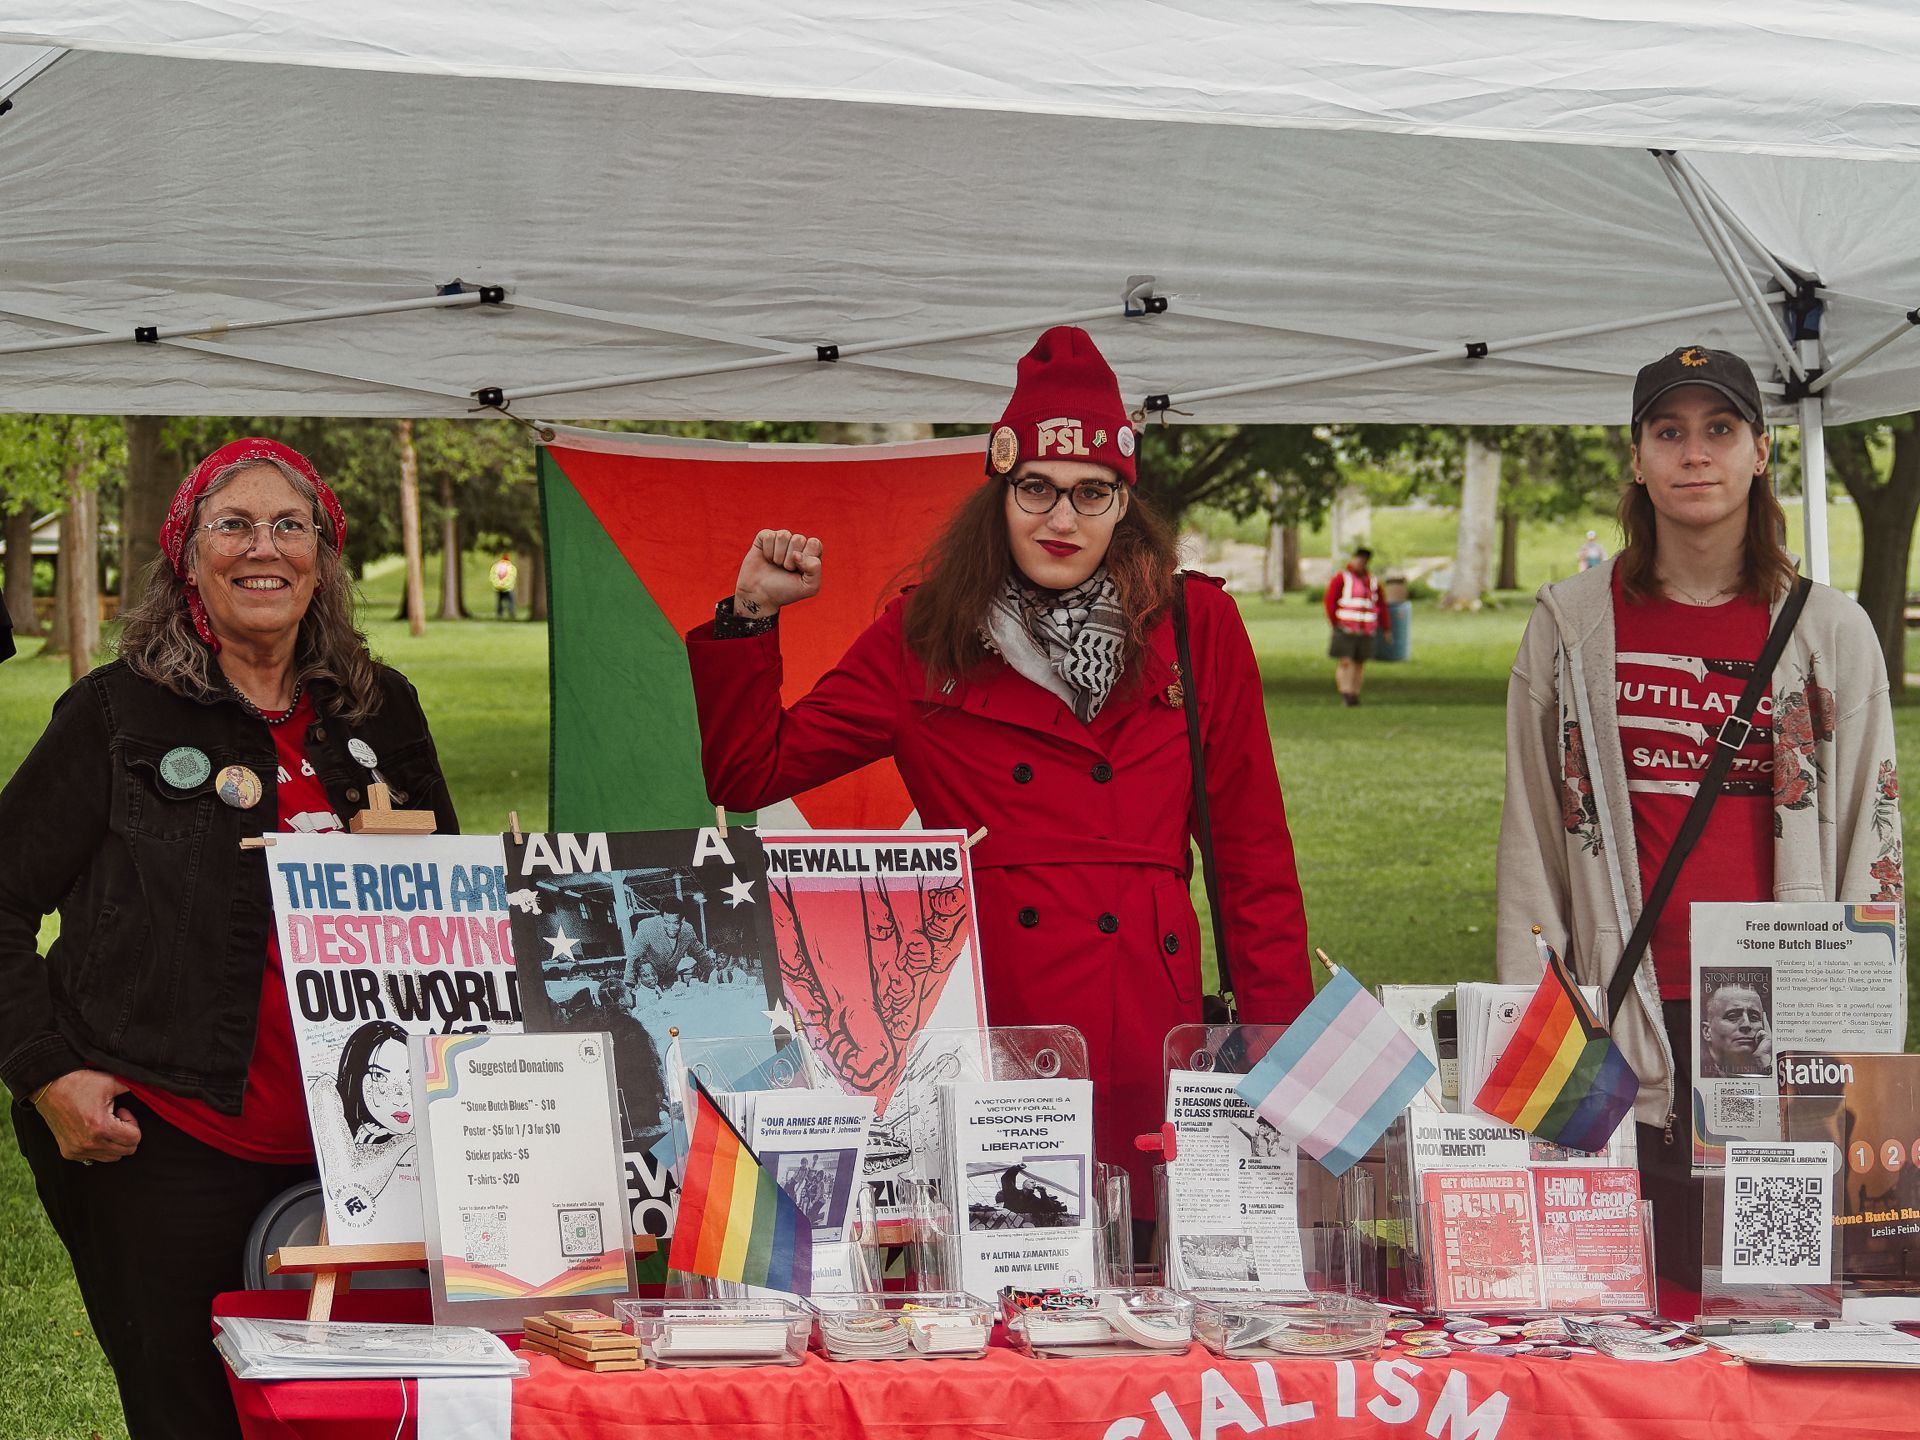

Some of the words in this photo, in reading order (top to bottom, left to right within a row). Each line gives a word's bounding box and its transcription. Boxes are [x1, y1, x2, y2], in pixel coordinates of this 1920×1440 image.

[1038, 429, 1089, 456] PSL
[1616, 681, 1773, 714] UTILATO
[1632, 748, 1774, 772] SALVTIO
[521, 831, 612, 875] AM
[693, 826, 736, 866] A
[876, 846, 957, 871] MEANS
[278, 862, 350, 910] THE
[351, 863, 443, 911] RICH
[1745, 921, 1770, 932] Free
[1774, 920, 1828, 932] download
[1832, 920, 1844, 932] of
[1736, 939, 1775, 950] “Stone
[1778, 939, 1811, 950] Butch
[1815, 939, 1852, 950] Blues”
[1738, 972, 1768, 982] BUTCH
[295, 969, 386, 1021] OUR
[469, 1059, 517, 1076] Suggested
[519, 1058, 564, 1073] Donations
[1778, 1058, 1854, 1087] Station
[488, 1100, 508, 1111] Butch
[510, 1100, 533, 1111] Blues”
[541, 1099, 556, 1110] $18
[1175, 1098, 1180, 1106] 5
[1183, 1098, 1221, 1107] REASONS
[970, 1115, 1032, 1125] LESSONS
[1036, 1114, 1076, 1122] FROM
[1174, 1109, 1182, 1117] IS
[1185, 1109, 1210, 1117] CLASS
[1213, 1109, 1254, 1118] STRUGGLE
[786, 1117, 816, 1126] ARMIES
[818, 1117, 831, 1125] ARE
[1175, 1121, 1179, 1131] 1
[463, 1125, 486, 1136] Poster
[492, 1125, 503, 1136] $5
[505, 1125, 514, 1135] for
[528, 1124, 533, 1134] 3
[534, 1124, 543, 1134] for
[546, 1123, 560, 1134] $10
[761, 1128, 780, 1136] Sylvia
[1416, 1127, 1441, 1141] JOIN
[1444, 1128, 1467, 1141] THE
[1468, 1127, 1526, 1141] SOCIALIST
[466, 1150, 490, 1161] Sticker
[493, 1149, 512, 1162] packs
[518, 1148, 529, 1159] $5
[1416, 1143, 1486, 1156] MOVEMENT!
[1856, 1148, 1865, 1167] 1
[1887, 1146, 1899, 1165] 2
[1239, 1158, 1246, 1169] 2
[468, 1174, 497, 1185] T-shirts
[503, 1173, 519, 1184] $20
[1440, 1178, 1457, 1188] GET
[1461, 1176, 1513, 1188] ORGANIZED
[1516, 1177, 1524, 1188] &
[1544, 1177, 1584, 1193] LENIN
[1544, 1192, 1588, 1207] STUDY
[1591, 1191, 1637, 1207] GROUP
[344, 1196, 367, 1216] PSL
[1240, 1203, 1246, 1214] 3
[1544, 1211, 1567, 1224] FOR
[1569, 1205, 1638, 1222] ORGANIZERS
[1865, 1209, 1899, 1222] Butch
[1872, 1227, 1895, 1237] Leslie
[981, 1252, 990, 1260] BY
[993, 1251, 1020, 1260] ALITHIA
[1022, 1249, 1069, 1258] ZAMANTAKIS
[994, 1265, 1009, 1273] AND
[1012, 1264, 1032, 1272] AVIVA
[1034, 1262, 1059, 1271] LEVINE
[1588, 1272, 1630, 1280] THURSDAYS
[1454, 1272, 1535, 1299] FUTURE
